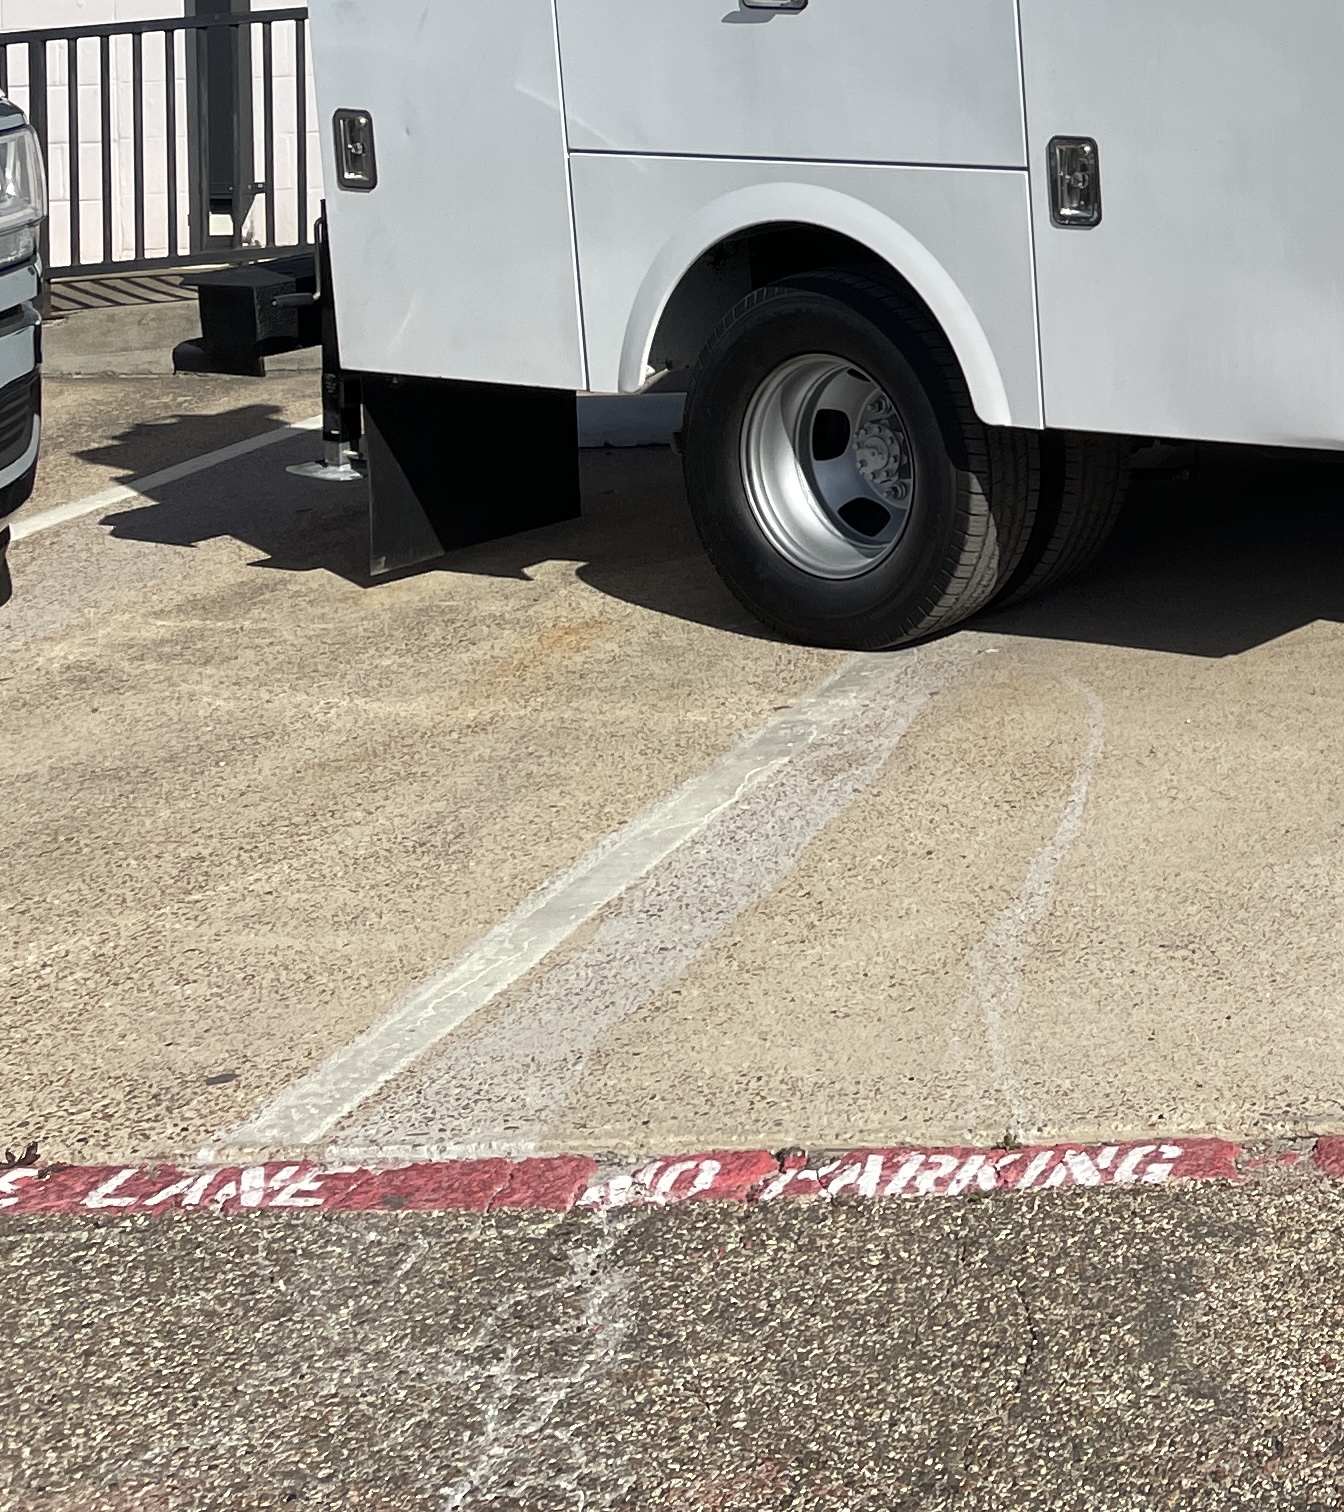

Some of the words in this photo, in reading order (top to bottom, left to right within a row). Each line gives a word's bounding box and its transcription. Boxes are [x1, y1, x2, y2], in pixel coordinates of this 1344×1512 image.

[82, 1165, 358, 1209] LANE
[574, 1160, 720, 1207] NO
[760, 1144, 1183, 1199] PARKING
